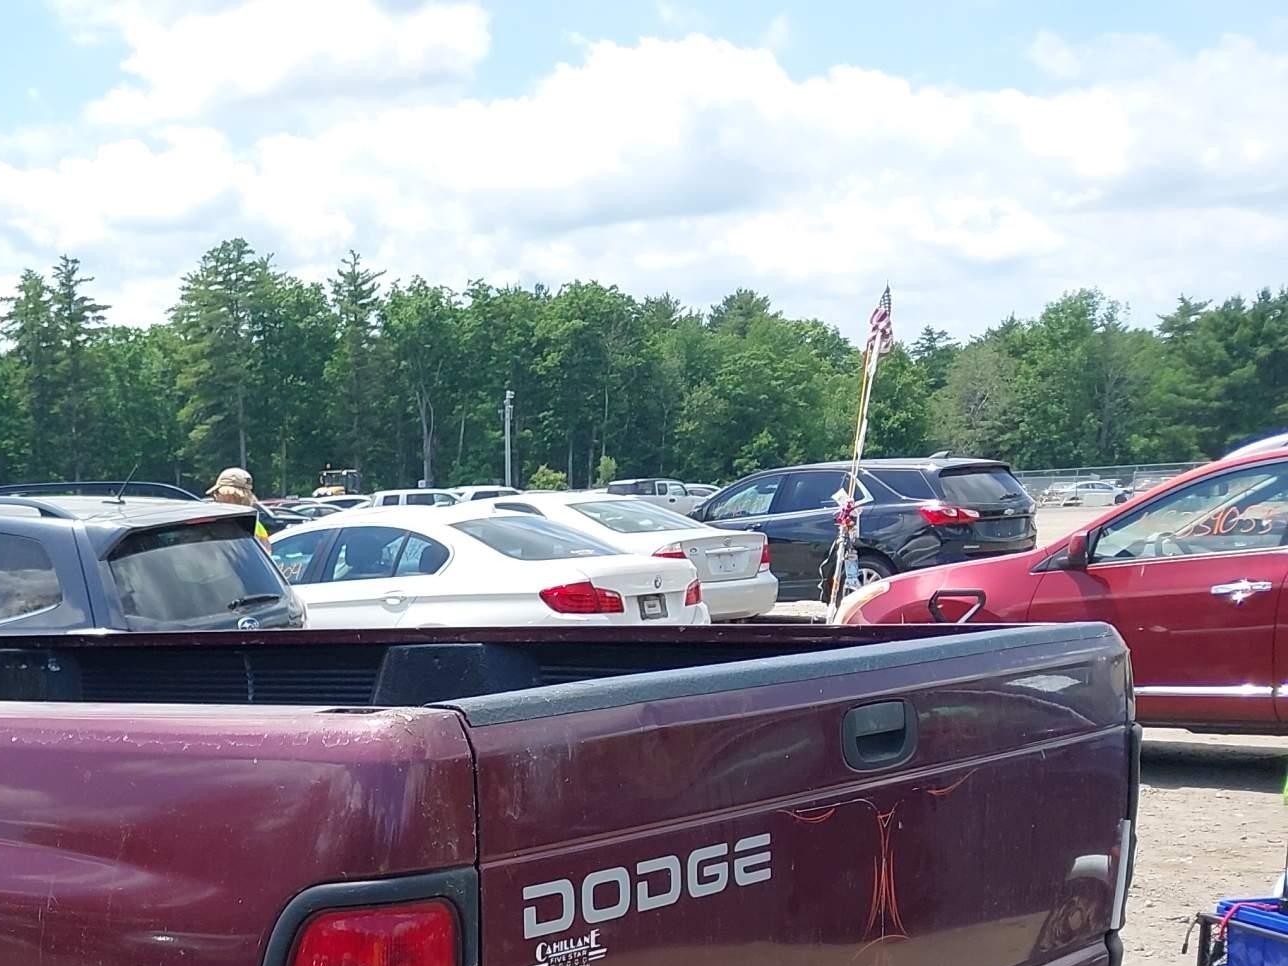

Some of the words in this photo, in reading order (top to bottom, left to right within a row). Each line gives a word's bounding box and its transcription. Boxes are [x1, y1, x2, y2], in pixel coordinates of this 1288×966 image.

[523, 832, 772, 939] DODGE
[550, 954, 567, 963] FIVE
[568, 950, 588, 960] STAR
